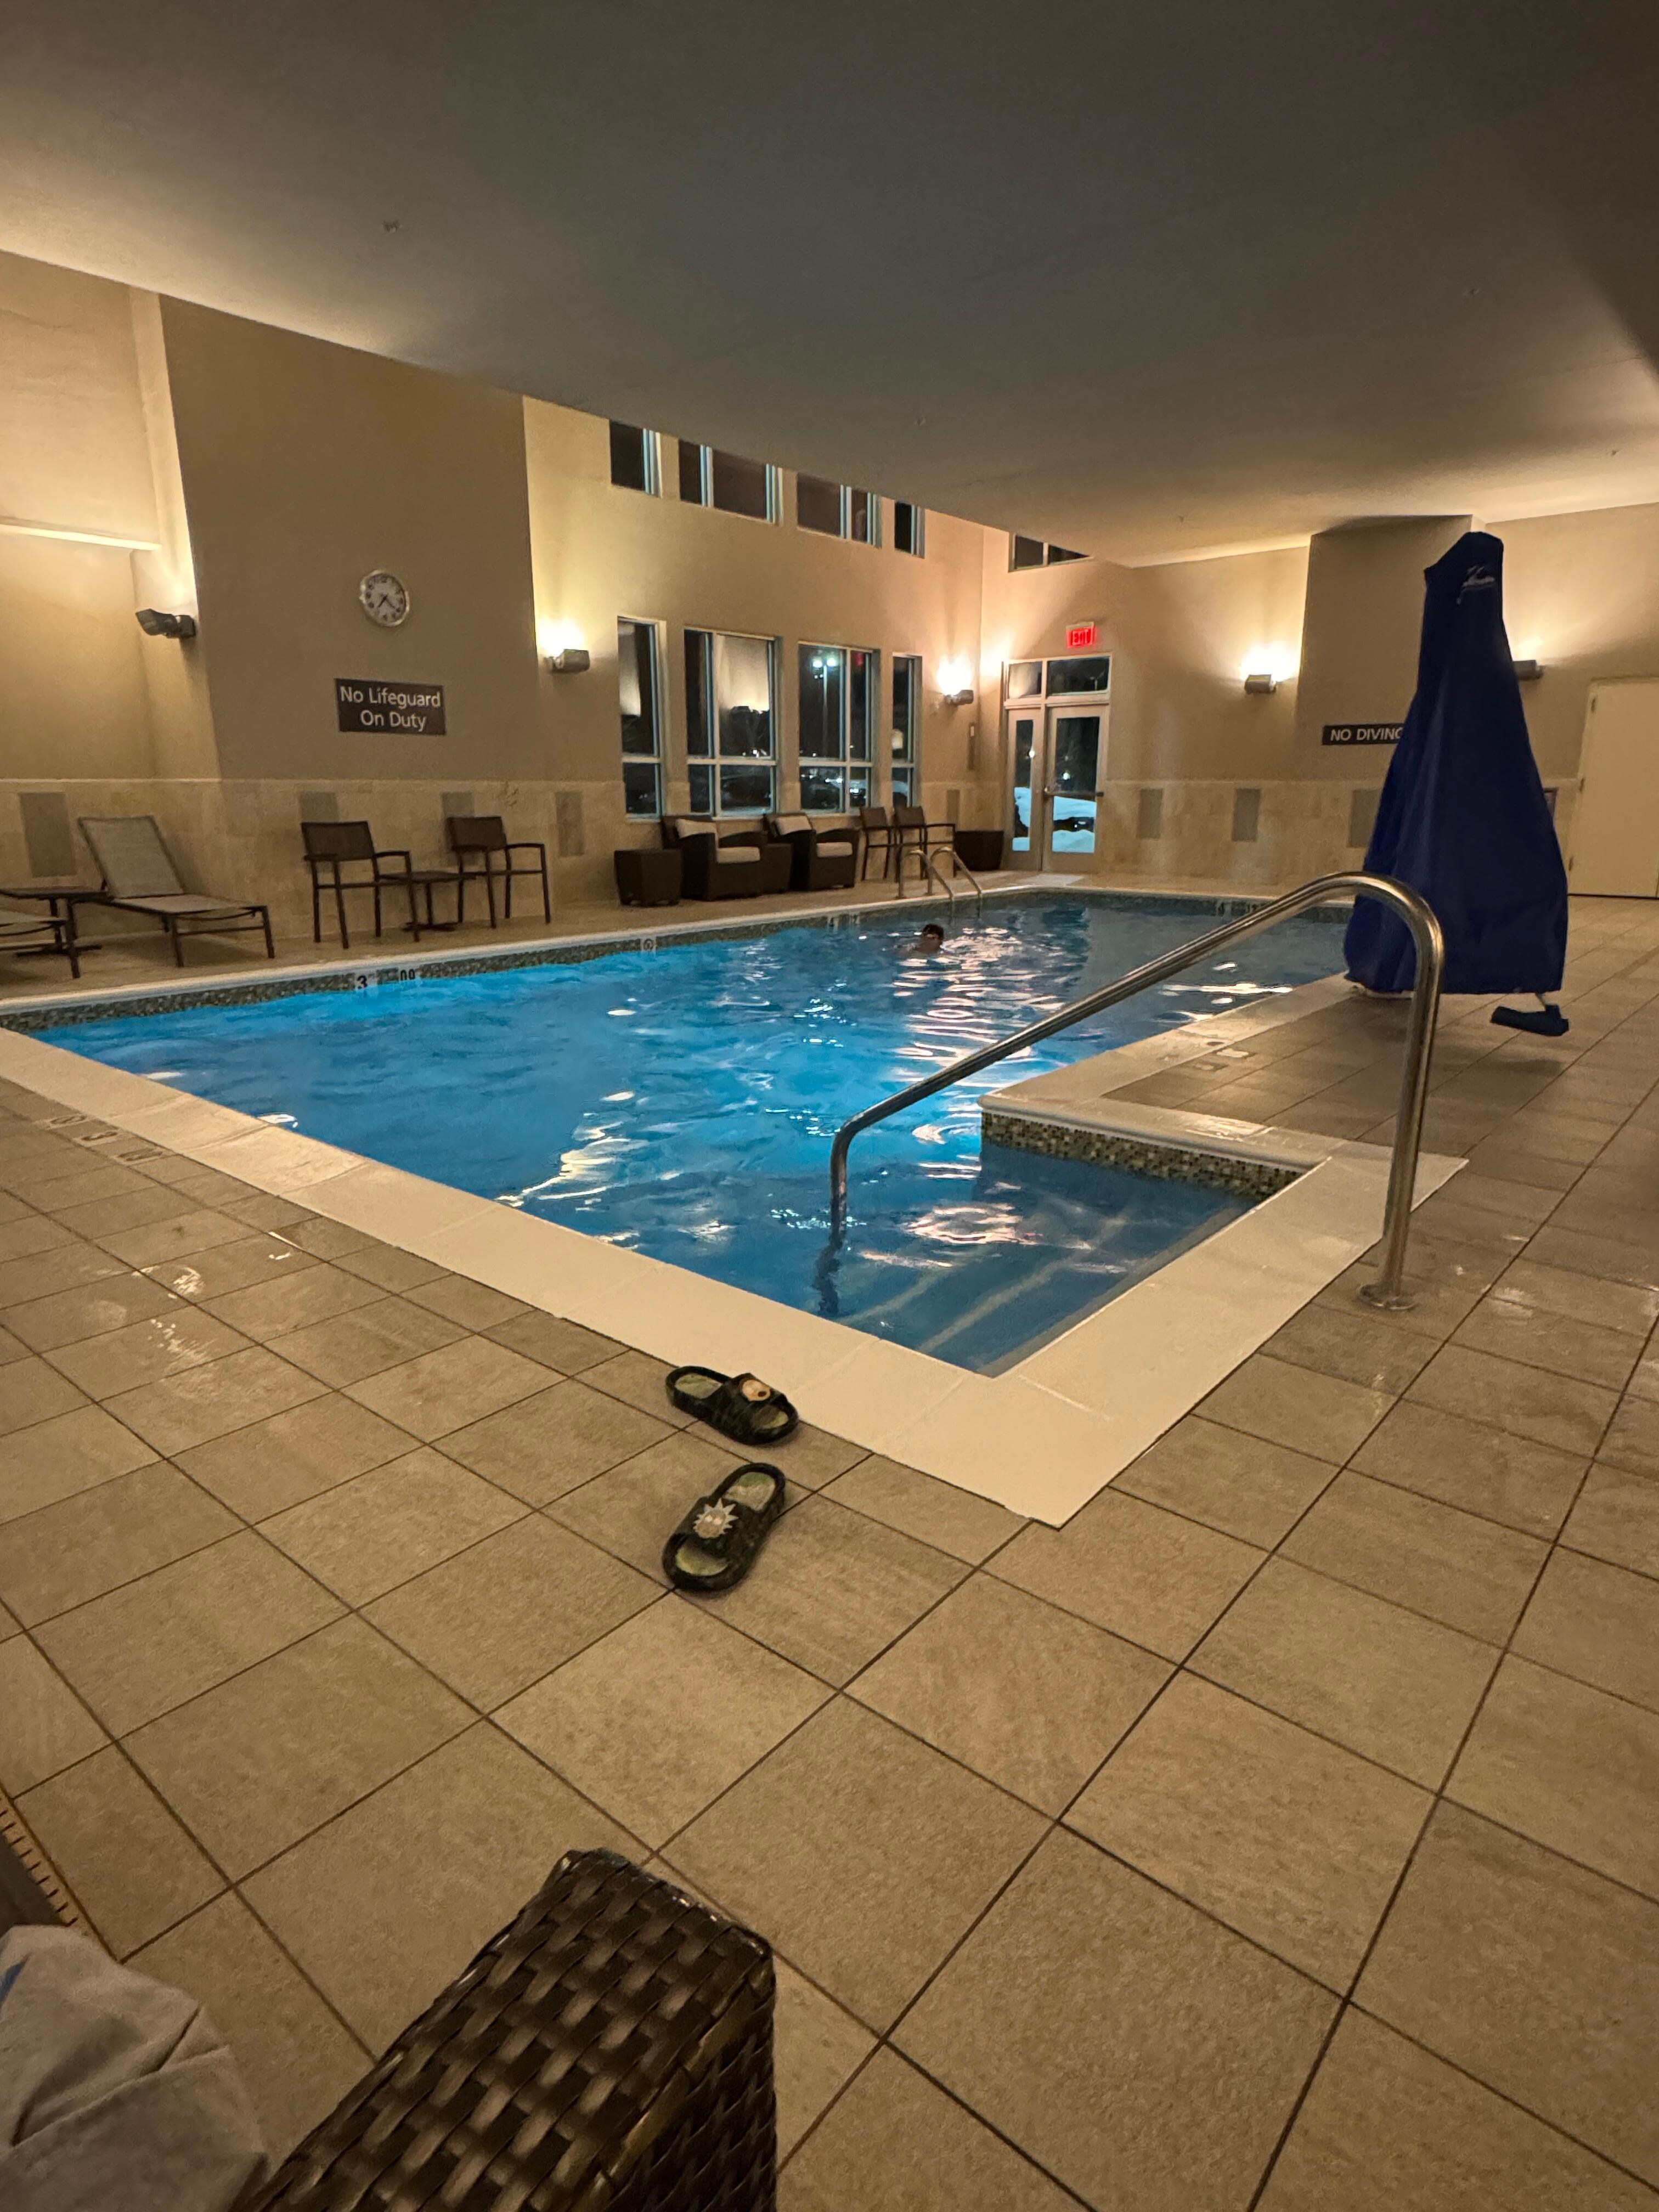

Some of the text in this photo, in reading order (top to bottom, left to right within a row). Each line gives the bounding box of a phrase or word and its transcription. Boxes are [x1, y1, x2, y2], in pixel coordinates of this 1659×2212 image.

[1072, 629, 1088, 645] EXIT
[340, 686, 441, 710] No Lifeguard
[360, 710, 427, 732] On Duty
[1330, 729, 1352, 741] NO
[357, 974, 368, 989] 3
